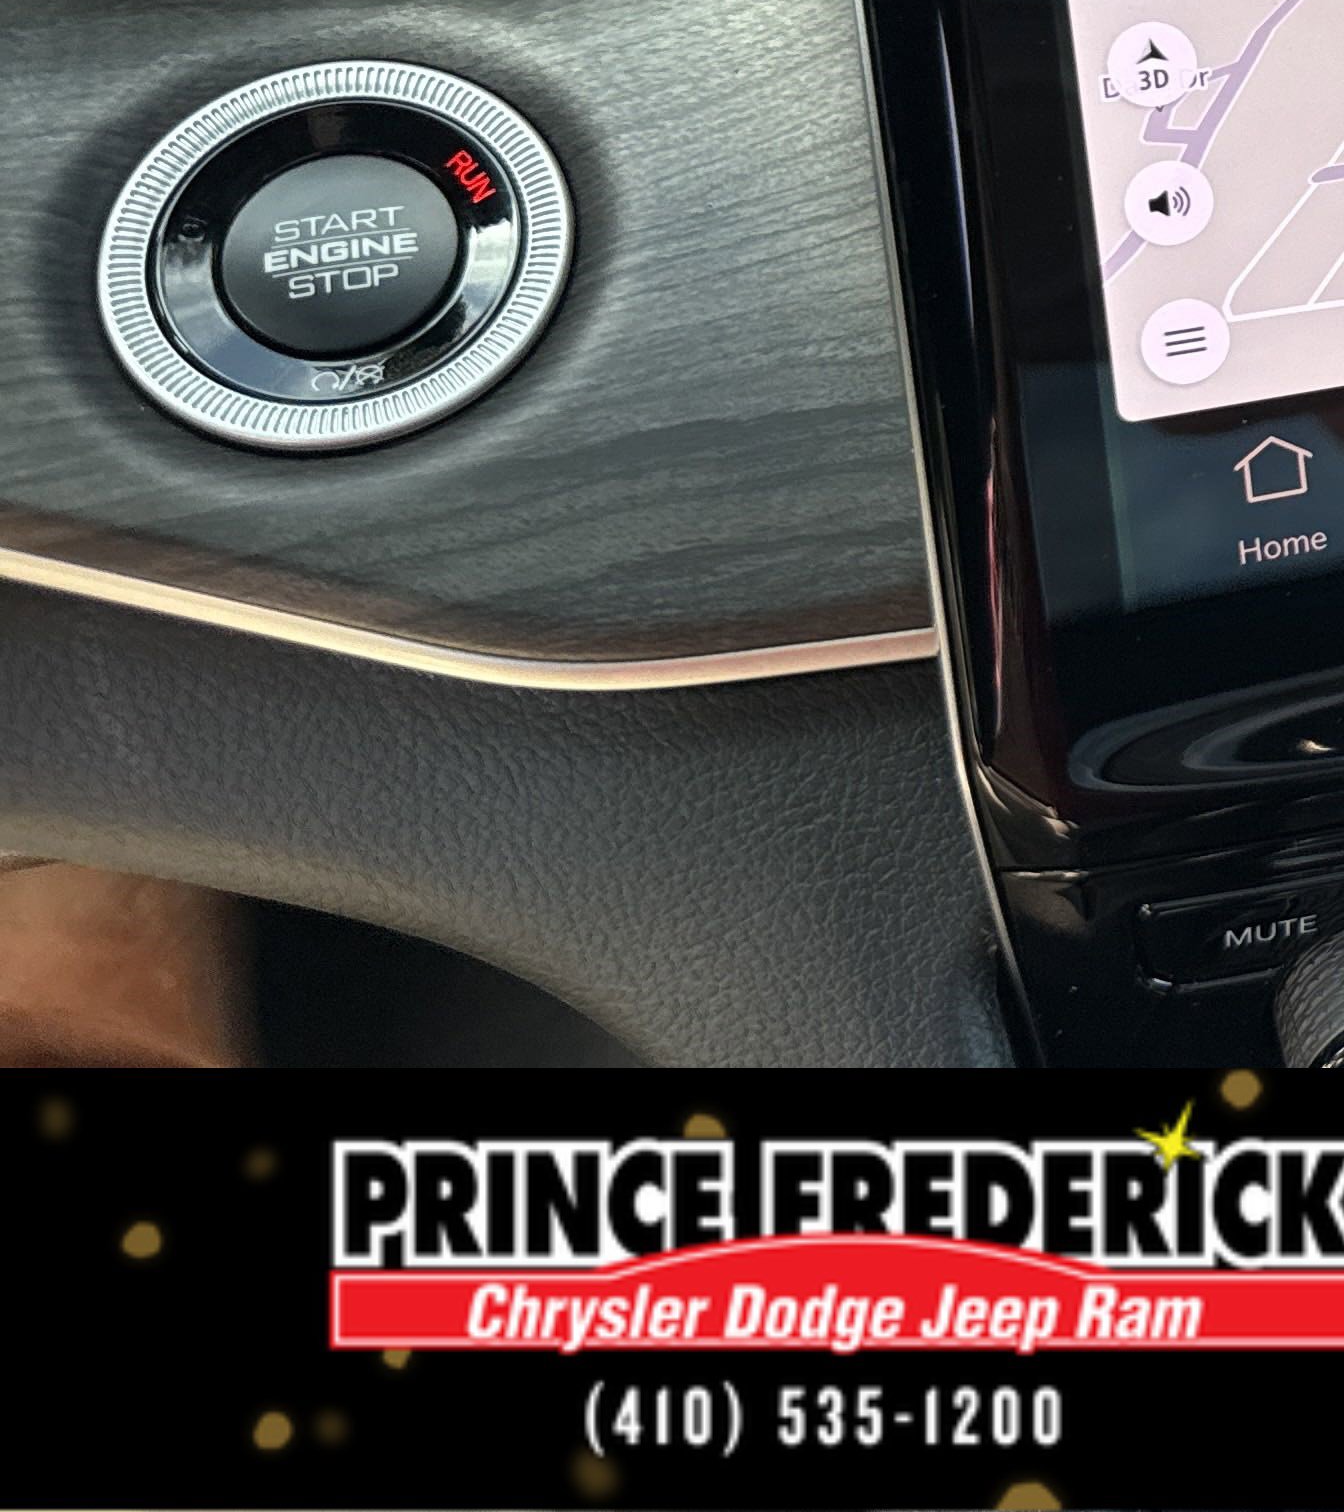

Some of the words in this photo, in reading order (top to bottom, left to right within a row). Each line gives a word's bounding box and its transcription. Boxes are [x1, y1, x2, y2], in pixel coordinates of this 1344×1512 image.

[1138, 68, 1170, 91] 3D
[446, 148, 498, 205] RUN
[273, 205, 405, 243] START
[263, 231, 419, 274] ENGINE
[286, 262, 400, 299] STOP
[1237, 531, 1328, 566] Home
[1222, 913, 1319, 950] MUTE
